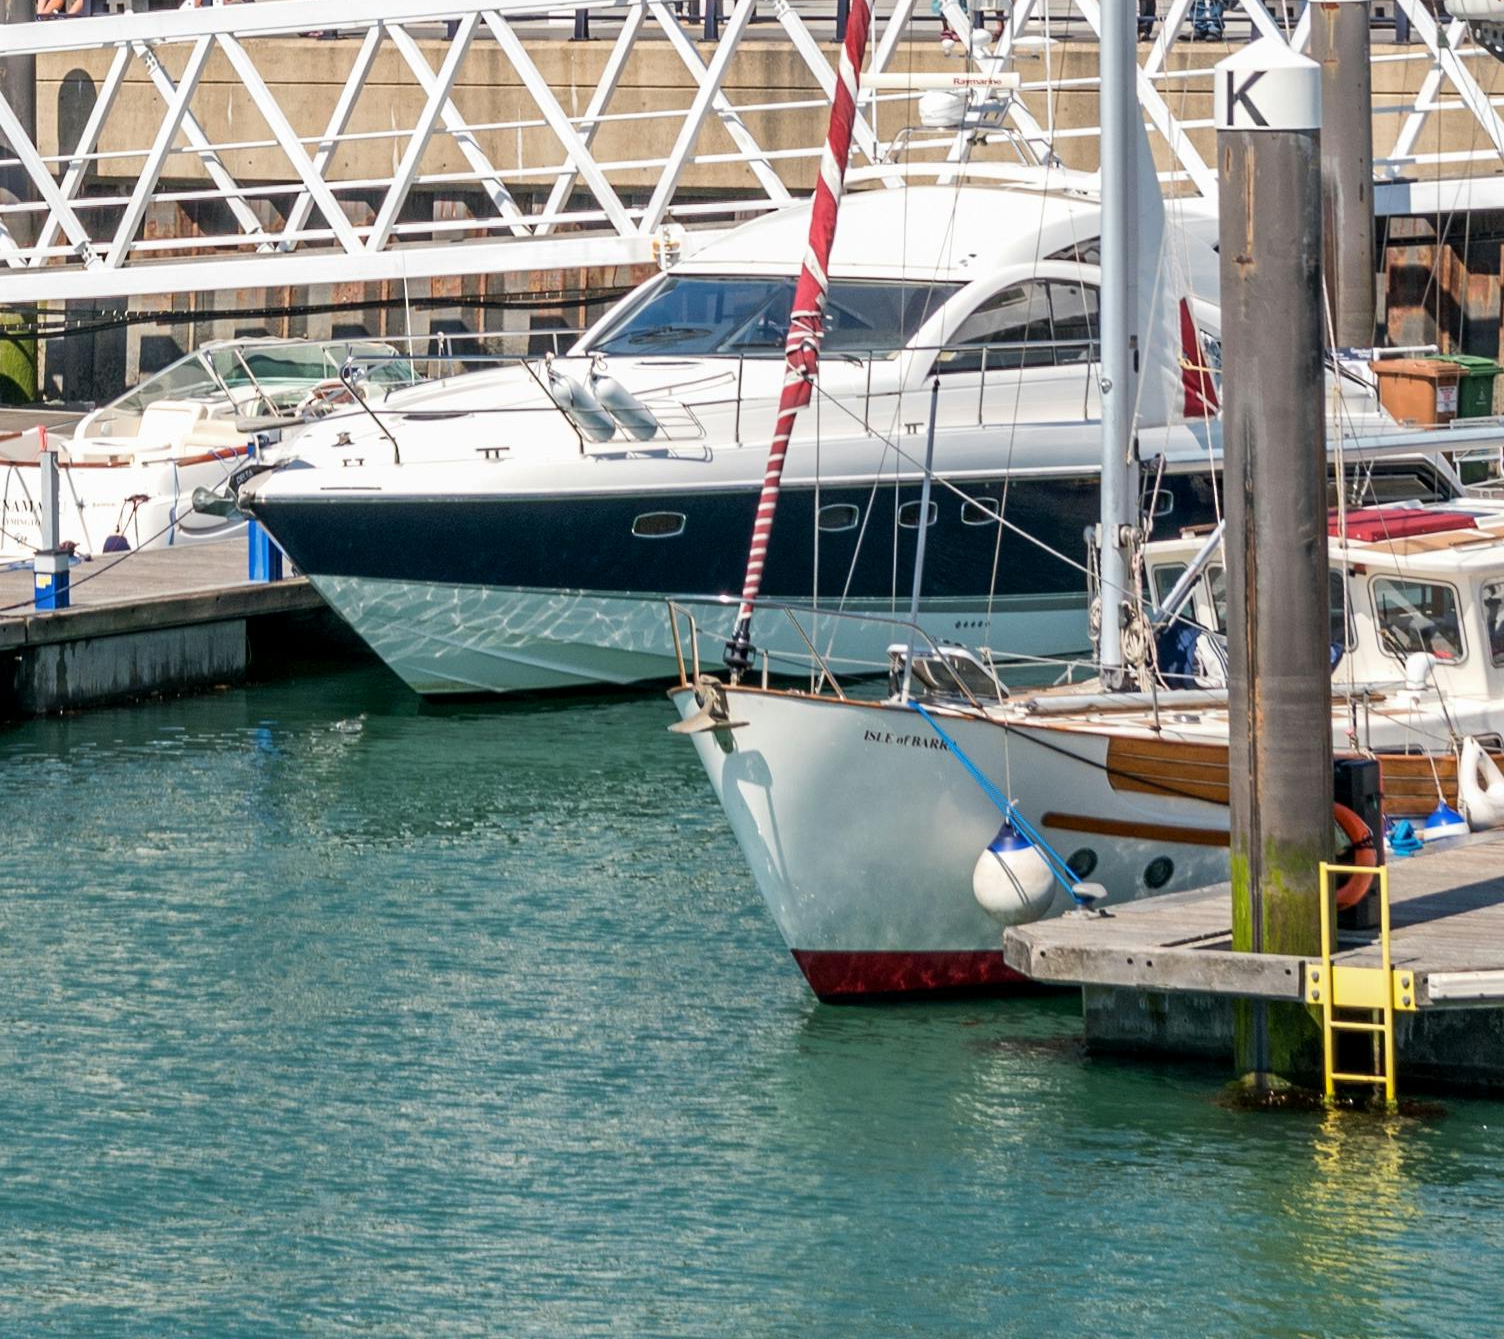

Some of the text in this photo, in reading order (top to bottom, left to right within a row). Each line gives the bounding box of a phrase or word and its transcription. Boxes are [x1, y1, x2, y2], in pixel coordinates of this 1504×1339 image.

[1227, 70, 1270, 126] K
[864, 729, 894, 743] ISLE
[896, 733, 912, 745] of
